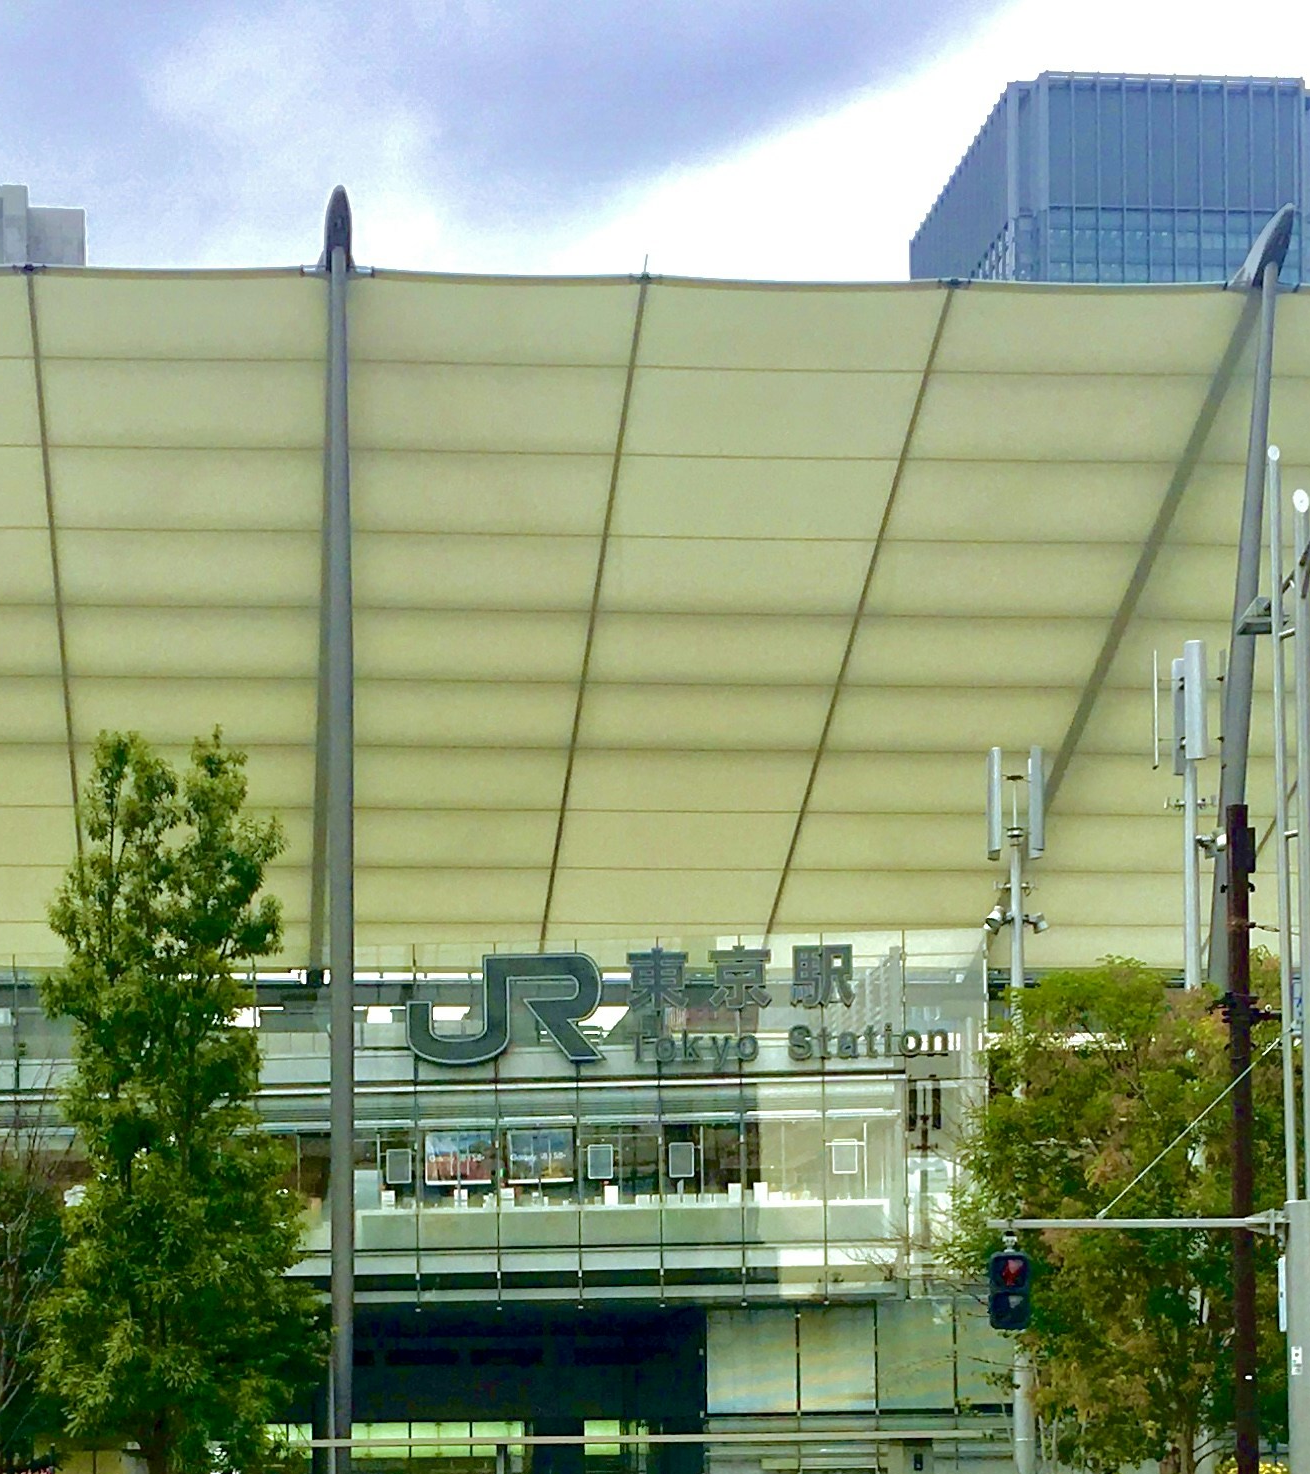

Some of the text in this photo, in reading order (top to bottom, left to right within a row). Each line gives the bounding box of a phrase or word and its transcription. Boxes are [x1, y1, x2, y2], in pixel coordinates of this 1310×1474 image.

[406, 944, 856, 1065] JR 東京駅
[632, 1022, 950, 1070] Tokyo Station
